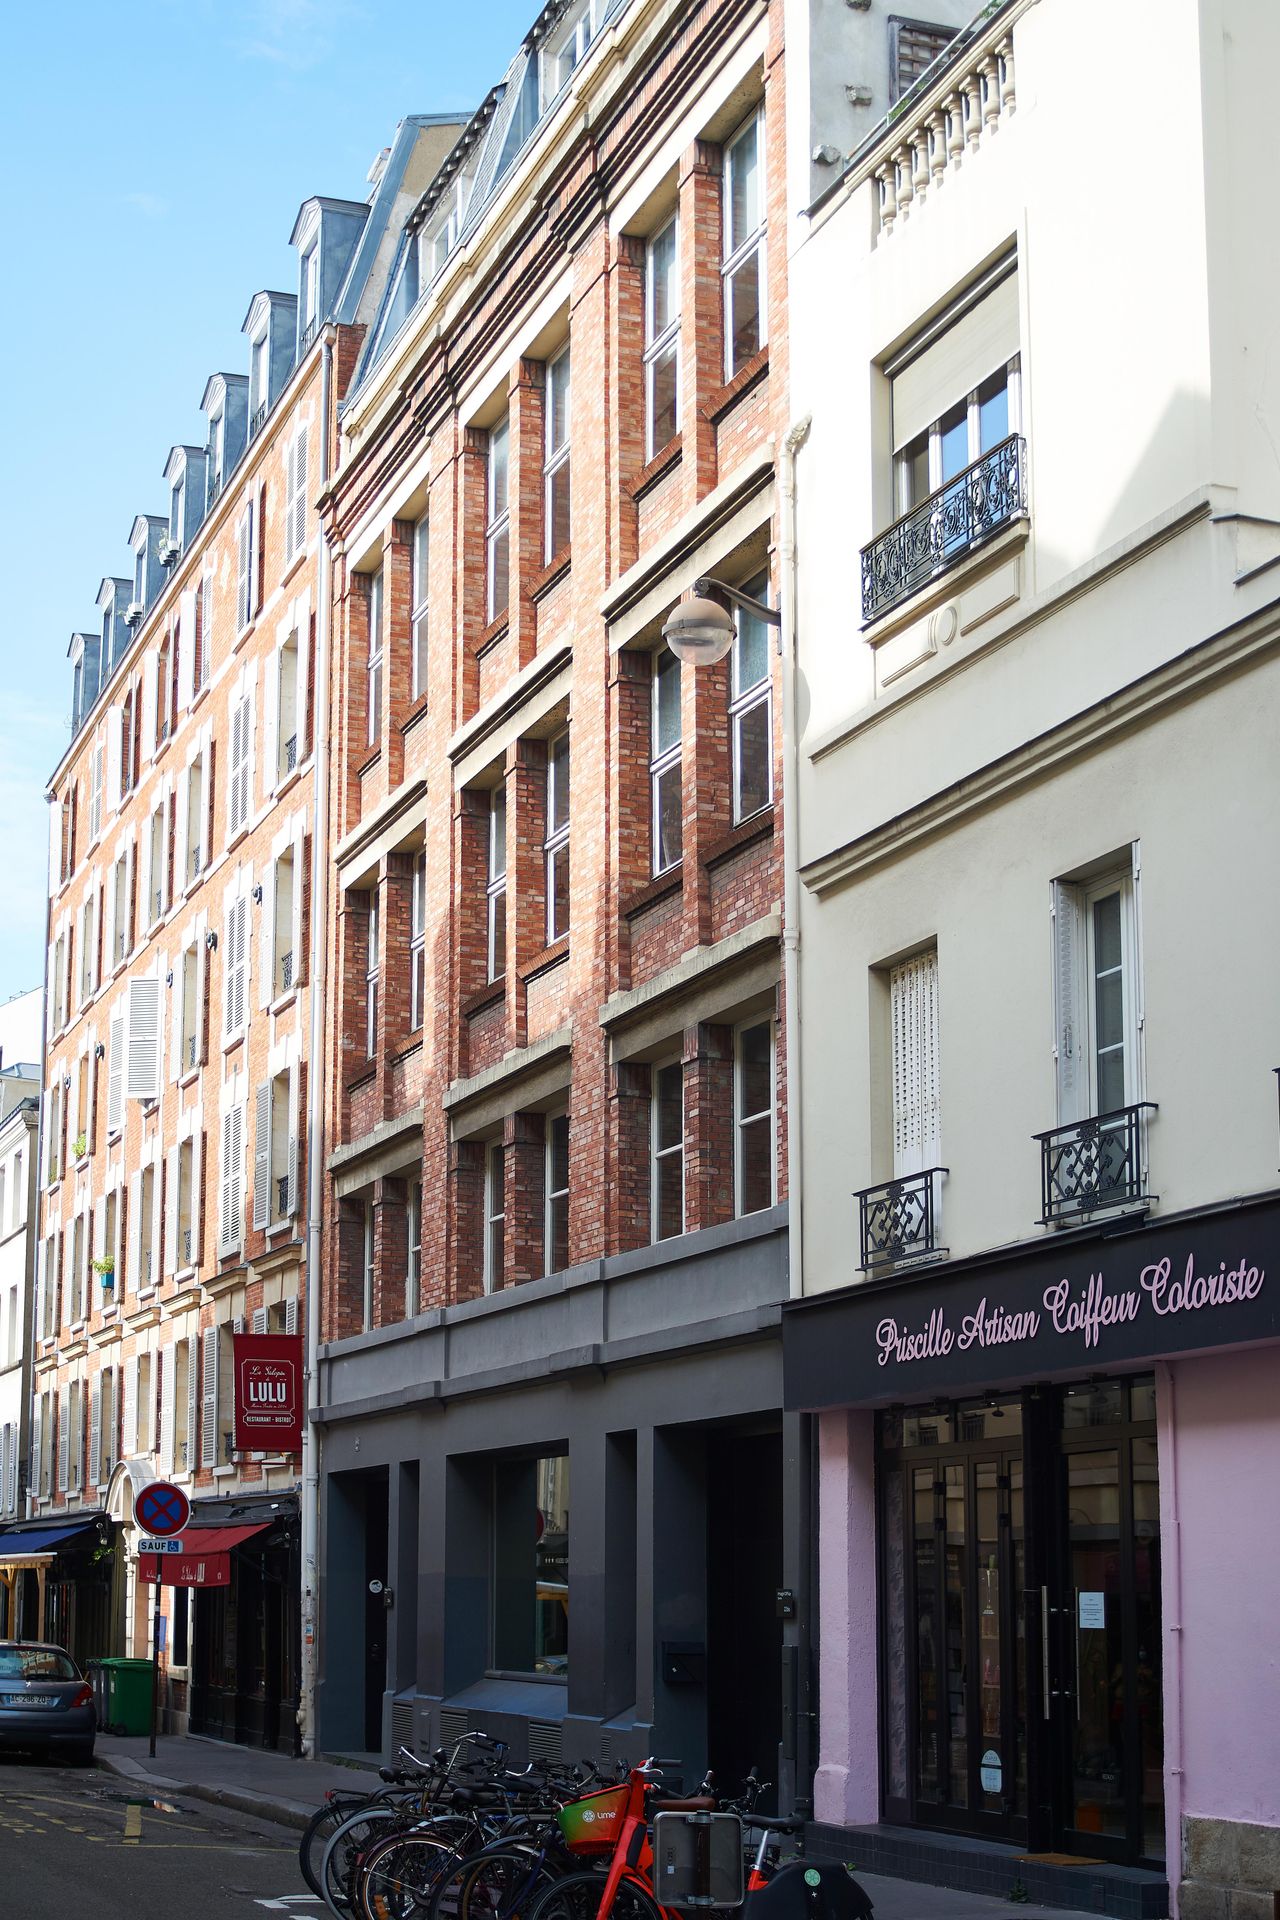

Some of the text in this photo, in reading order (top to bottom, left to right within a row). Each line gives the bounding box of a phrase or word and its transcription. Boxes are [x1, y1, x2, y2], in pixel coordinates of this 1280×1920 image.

[876, 1253, 1265, 1367] Priscille Artisan Coiffeur Coloriste
[249, 1382, 286, 1402] LULU
[141, 1542, 166, 1550] SAUF
